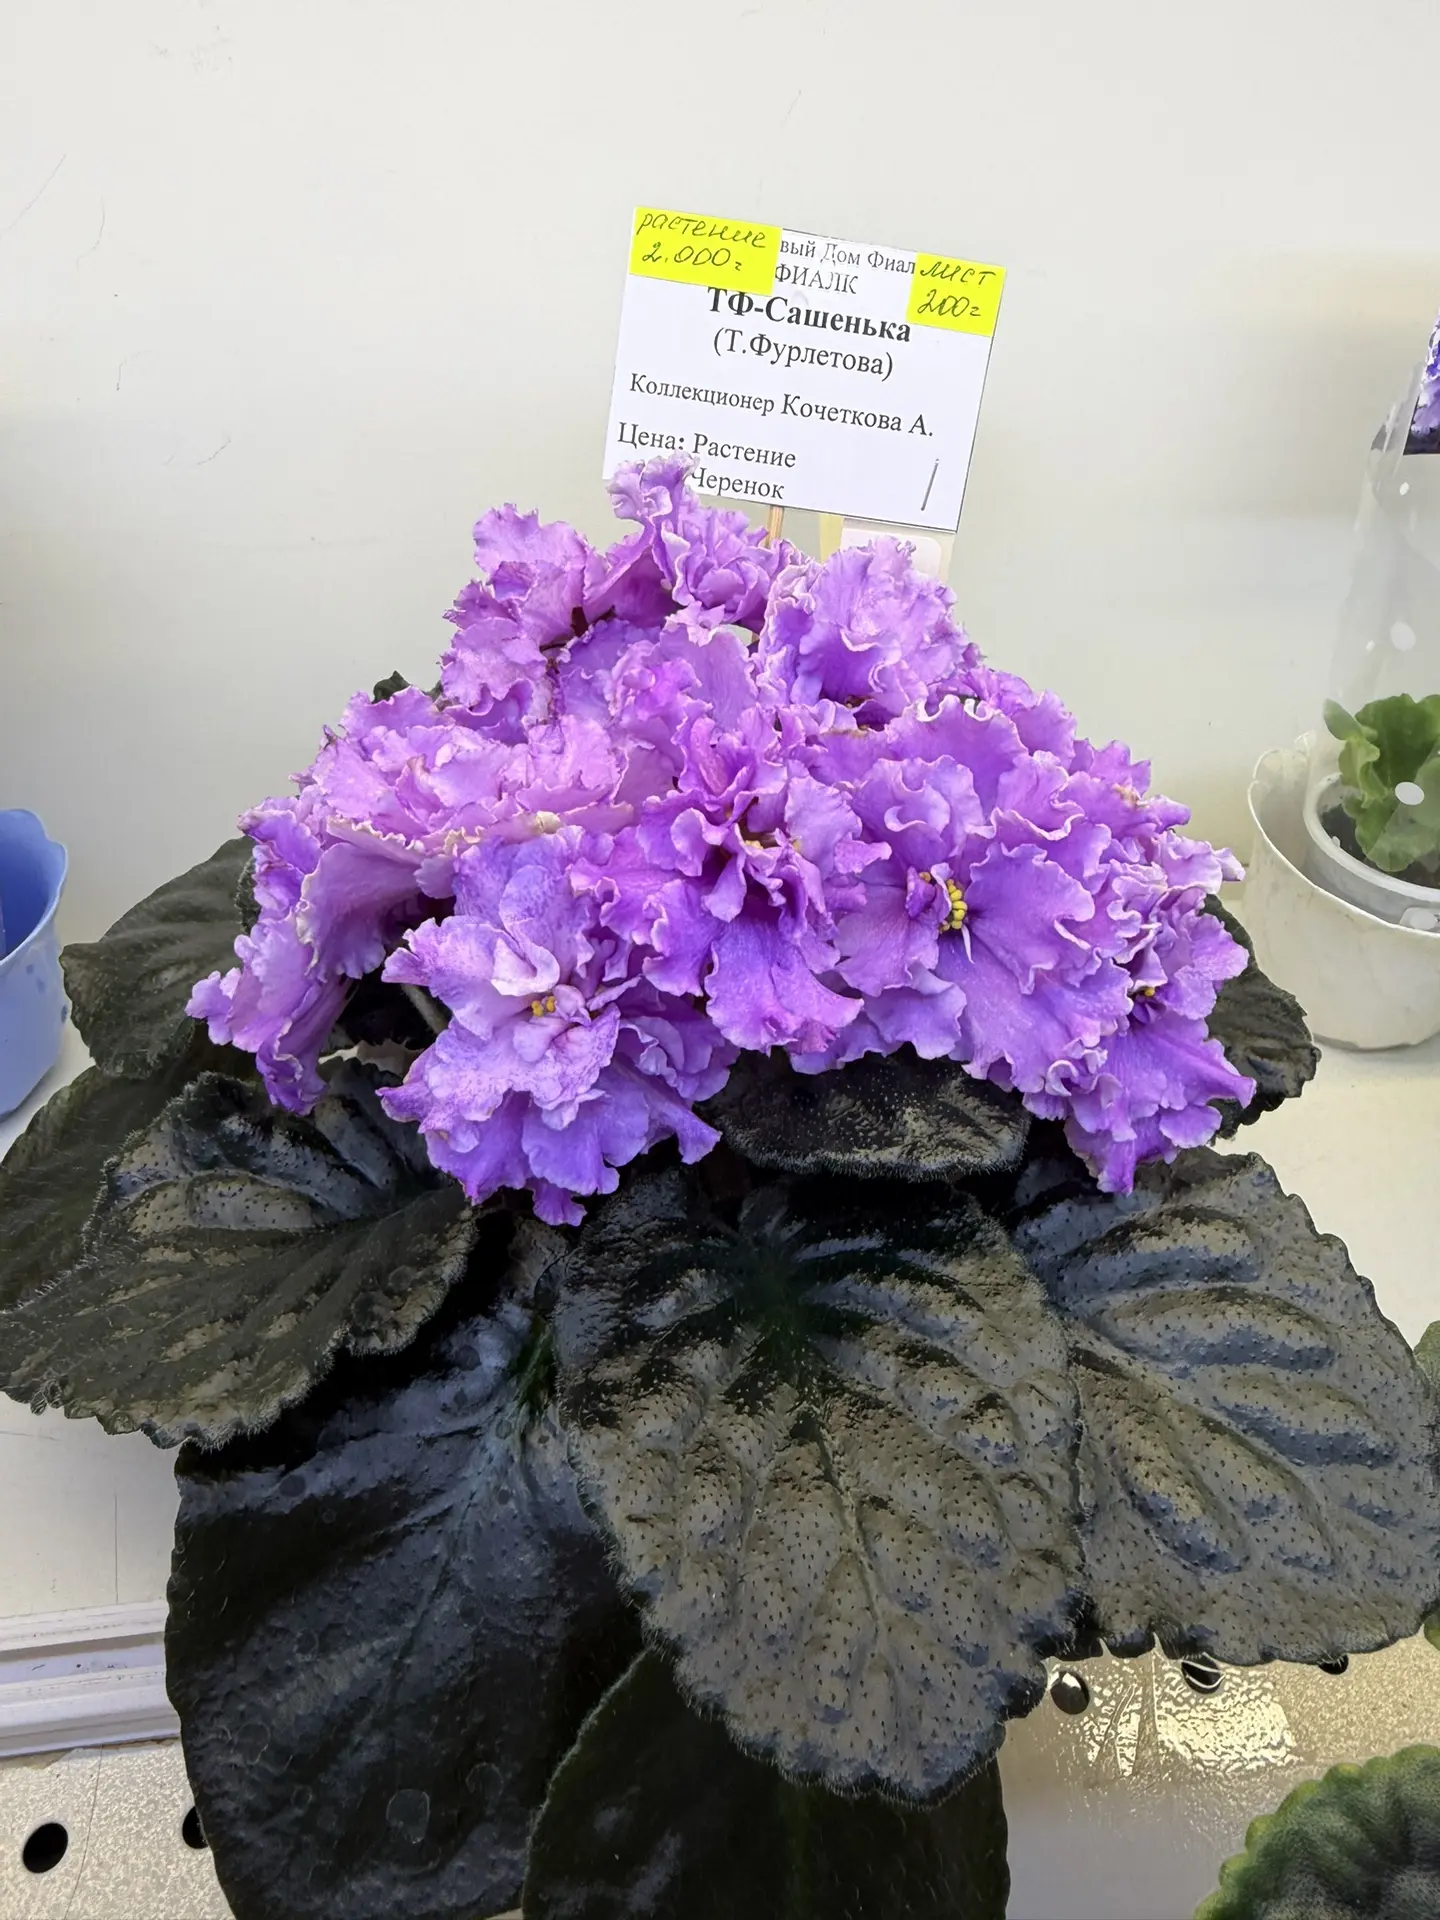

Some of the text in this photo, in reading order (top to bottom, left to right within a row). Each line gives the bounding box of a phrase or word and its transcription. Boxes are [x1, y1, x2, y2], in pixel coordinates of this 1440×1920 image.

[636, 213, 766, 248] растение
[820, 243, 861, 267] Дом
[708, 286, 911, 342] ТФ-Сашенька
[713, 326, 893, 381] (Т.Фурлетова)
[630, 373, 934, 438] Коллекционер Кочеткова А.
[617, 421, 796, 468] Цена: Растение
[691, 467, 785, 499] Черенок
